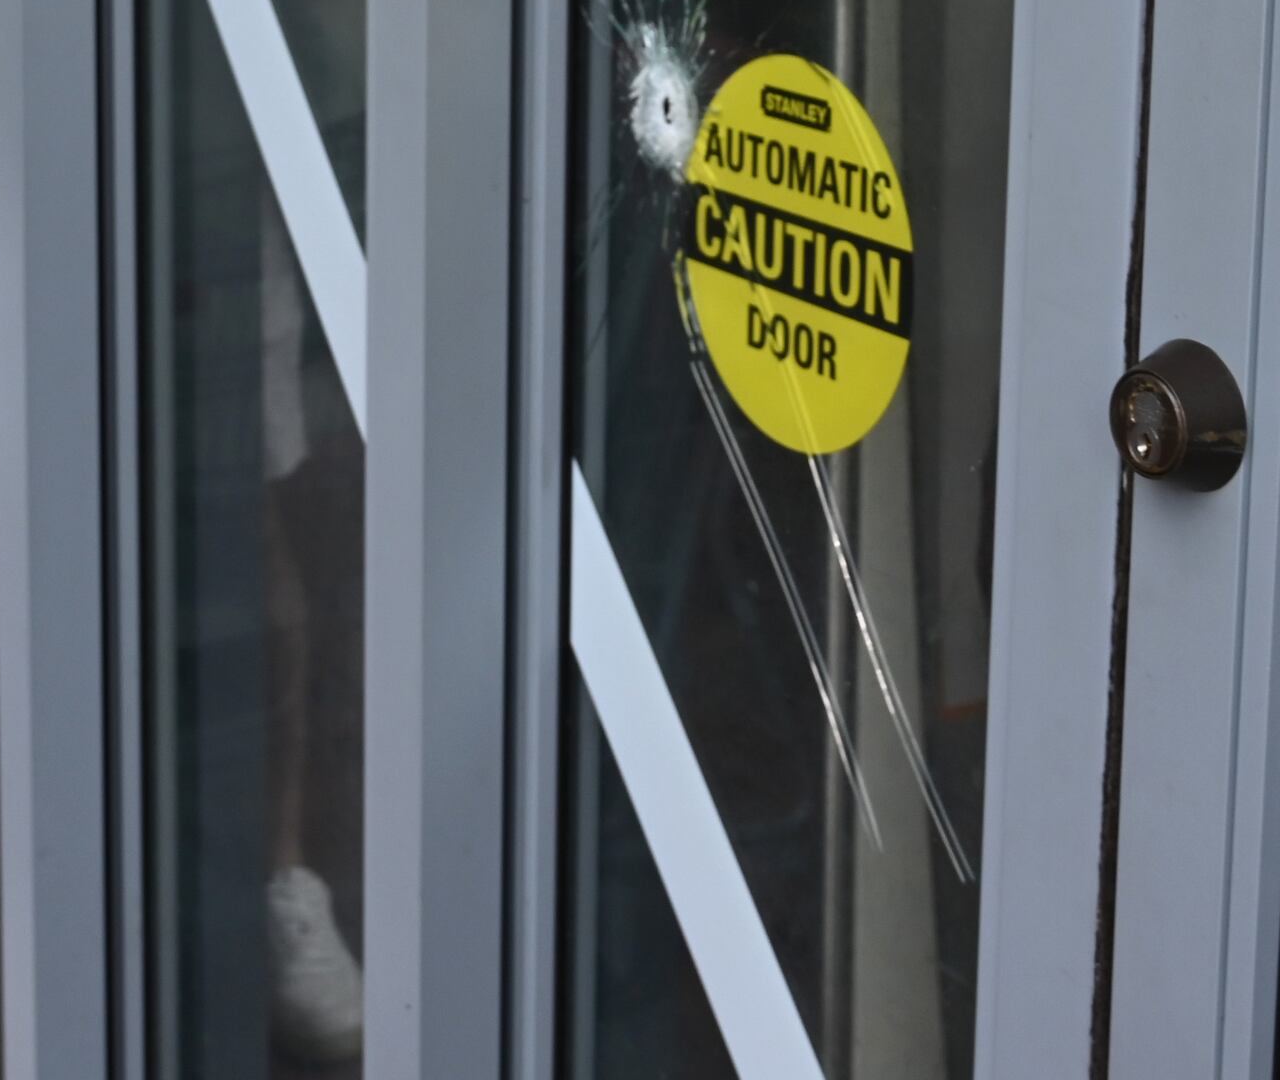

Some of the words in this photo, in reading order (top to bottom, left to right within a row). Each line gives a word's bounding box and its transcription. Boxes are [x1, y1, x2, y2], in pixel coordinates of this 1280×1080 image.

[764, 91, 828, 124] STANLEY
[704, 124, 891, 219] AUTOMATIC
[695, 193, 901, 325] CAUTION
[747, 304, 837, 380] DOOR
